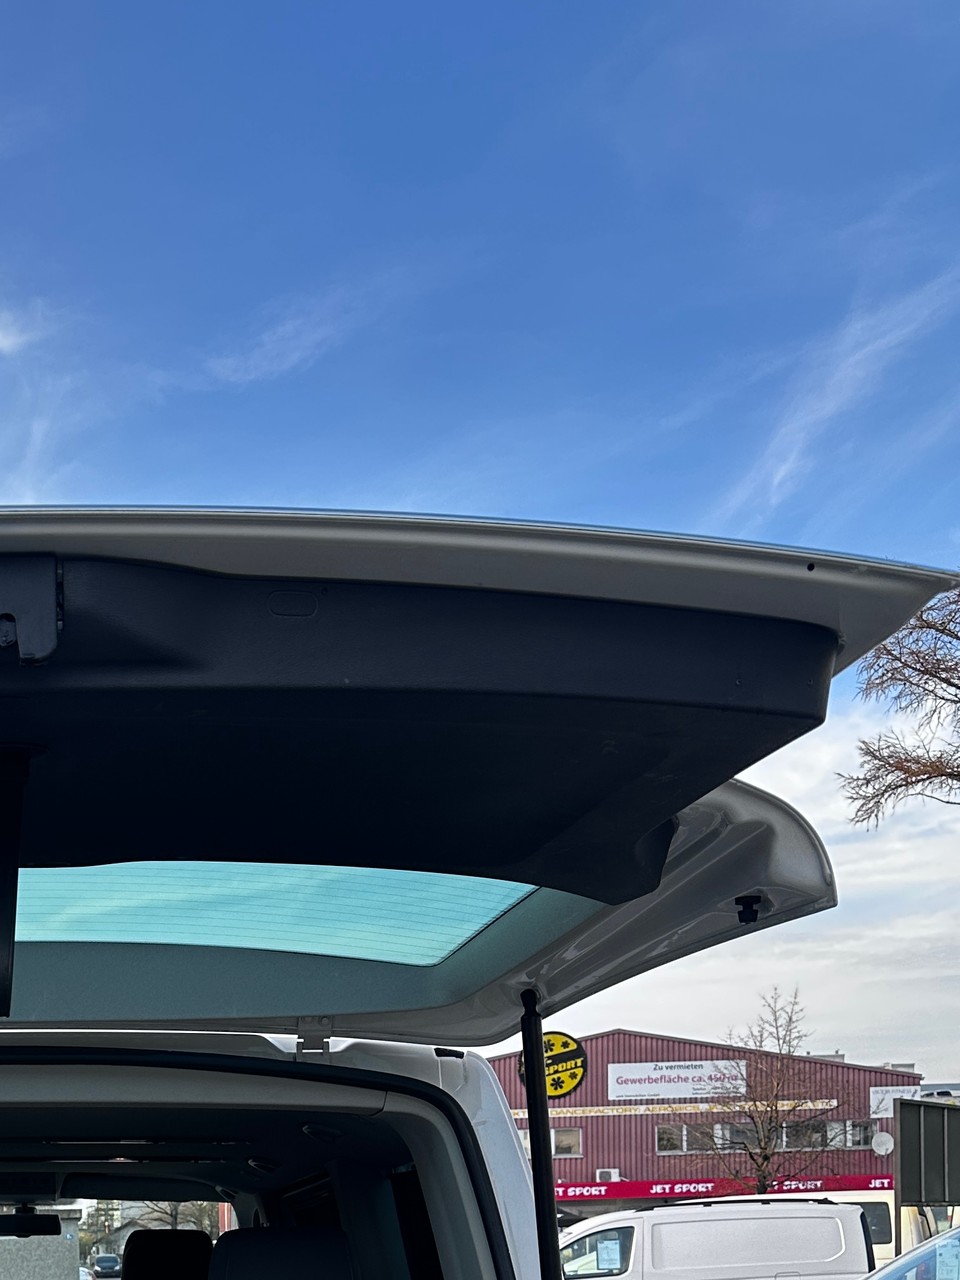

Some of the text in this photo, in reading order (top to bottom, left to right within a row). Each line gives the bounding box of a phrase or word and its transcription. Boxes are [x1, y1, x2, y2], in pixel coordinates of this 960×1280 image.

[653, 1062, 704, 1071] Zu vermieten
[616, 1073, 690, 1086] Gewerbefläche
[649, 1182, 715, 1194] JET SPORT
[868, 1178, 891, 1189] JET
[567, 1186, 608, 1197] SPORT
